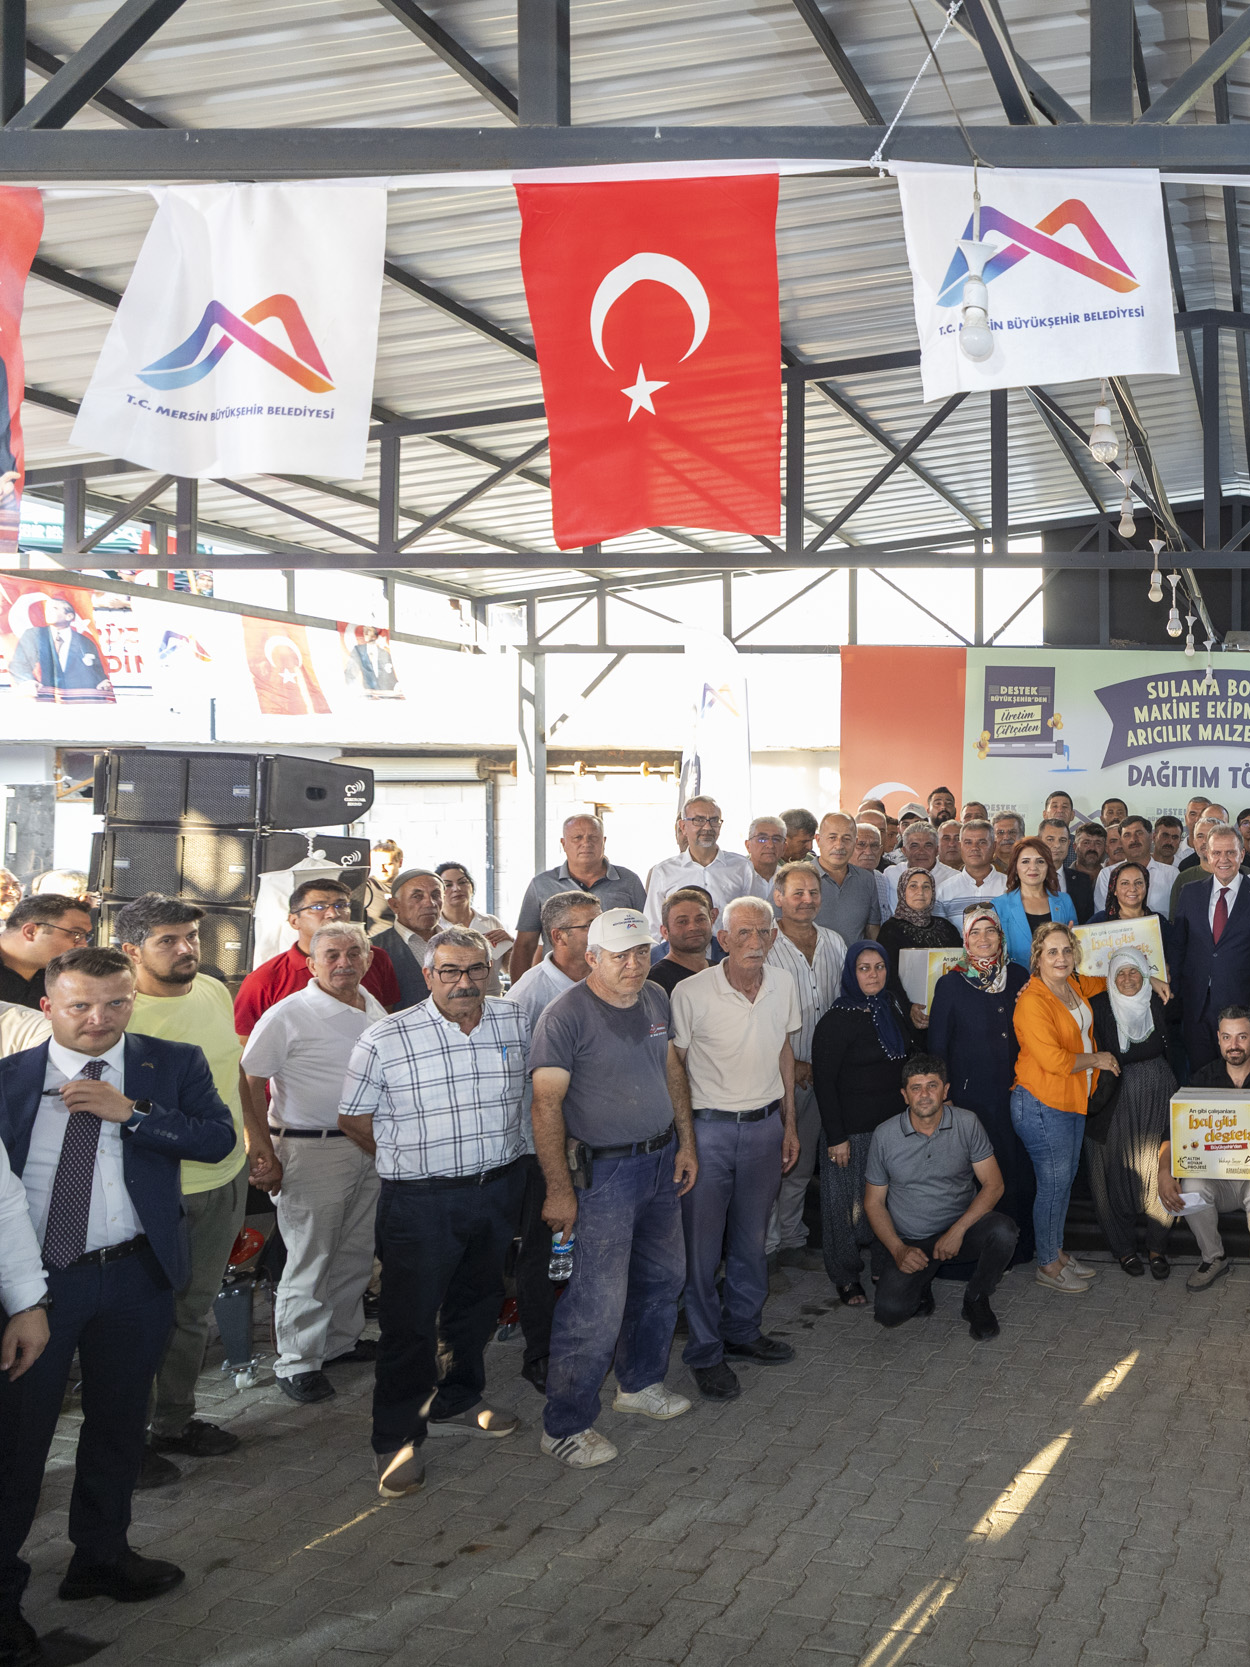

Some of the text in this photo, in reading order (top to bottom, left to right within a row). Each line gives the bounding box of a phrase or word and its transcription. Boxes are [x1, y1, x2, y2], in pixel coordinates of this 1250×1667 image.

[939, 324, 956, 336] T.C.
[1007, 312, 1080, 330] BÜYÜKŞEHİR
[1084, 306, 1145, 322] BELEDİYESİ
[126, 394, 335, 422] T.C. MERSİN BÜYÜKŞEHİR BELEDİYESİ
[1000, 686, 1038, 694] DESTEK
[1146, 679, 1220, 700] SULAMA
[1001, 710, 1034, 722] Üretim
[1134, 699, 1200, 724] MAKİNE
[996, 724, 1040, 737] Çiftçiden
[1127, 724, 1192, 748] ARICILIK
[1128, 760, 1220, 788] DAĞITIM
[1189, 1115, 1237, 1130] bal gibi
